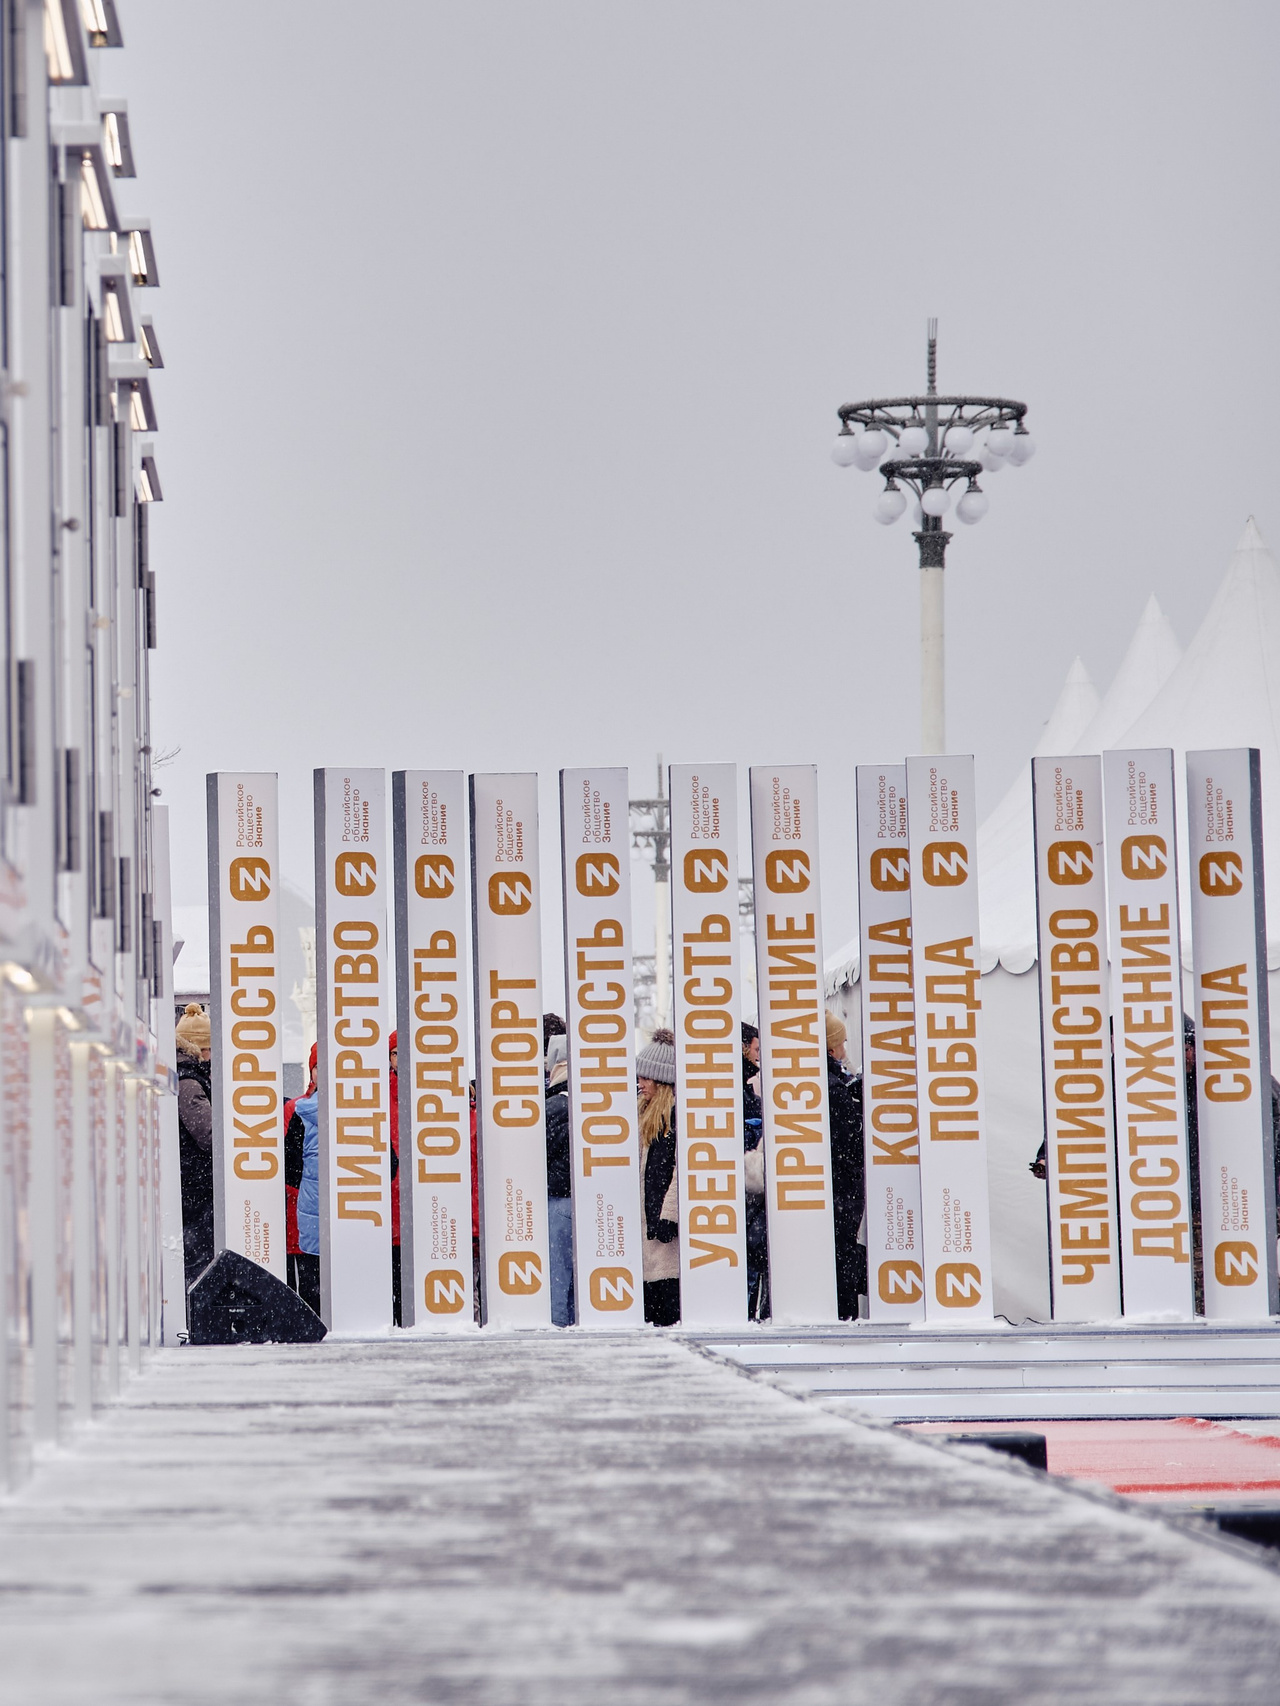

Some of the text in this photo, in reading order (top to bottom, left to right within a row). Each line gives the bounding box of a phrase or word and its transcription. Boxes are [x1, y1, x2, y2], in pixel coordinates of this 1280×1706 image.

[235, 783, 246, 848] Российское
[341, 777, 351, 842] Российское
[350, 788, 362, 843] общество
[420, 780, 430, 845] Российское
[429, 792, 439, 846] общество
[581, 779, 592, 844] Российское
[591, 790, 602, 844] общество
[689, 775, 701, 840] Российское
[700, 786, 711, 840] общество
[710, 797, 720, 840] Знание
[770, 776, 782, 841] Российское
[781, 787, 792, 841] общество
[791, 798, 802, 840] Знание
[876, 774, 887, 839] Российское
[887, 785, 898, 839] общество
[897, 796, 907, 839] Знание
[928, 767, 939, 832] Российское
[939, 778, 950, 833] общество
[949, 789, 960, 832] Знание
[1053, 766, 1064, 832] Российское
[1064, 777, 1075, 832] общество
[1074, 789, 1085, 831] Знание
[1126, 760, 1138, 826] Российское
[1137, 771, 1148, 826] общество
[1147, 782, 1158, 825] Знание
[1204, 777, 1215, 843] Российское
[1214, 788, 1225, 842] общество
[1224, 799, 1235, 842] Знание
[245, 794, 255, 848] общество
[254, 805, 264, 848] Знание
[360, 800, 370, 843] Знание
[438, 803, 448, 846] Знание
[494, 798, 505, 863] Российское
[504, 809, 515, 863] общество
[514, 821, 524, 863] Знание
[601, 801, 612, 844] Знание
[230, 925, 279, 1180] СКОРОСТЬ
[414, 930, 465, 1183] ГОРДОСТЬ
[489, 970, 540, 1127] СПОРТ
[576, 919, 630, 1176] ТОЧНОСТЬ
[868, 918, 919, 1165] КОМАНДА
[924, 937, 981, 1141] ПОБЕДА
[1201, 964, 1252, 1102] СИЛА
[333, 921, 387, 1226] ЛИДЕРСТВО
[767, 913, 825, 1210] ПРИЗНАНИЕ
[1119, 904, 1189, 1262] ДОСТИЖЕНИЕ
[683, 914, 738, 1268] УВЕРЕННОСТЬ
[1048, 909, 1110, 1284] ЧЕМПИОНСТВО
[504, 1178, 515, 1242] Российское
[514, 1188, 525, 1242] общество
[524, 1200, 534, 1242] Знание
[594, 1193, 606, 1258] Российское
[884, 1186, 895, 1251] Российское
[894, 1197, 905, 1251] общество
[941, 1187, 952, 1253] Российское
[952, 1198, 963, 1253] общество
[1219, 1166, 1230, 1232] Российское
[1230, 1177, 1240, 1232] общество
[1239, 1189, 1250, 1231] Знание
[242, 1198, 252, 1258] оссийское
[261, 1222, 270, 1264] Знание
[430, 1195, 440, 1260] Российское
[439, 1206, 449, 1260] общество
[448, 1218, 458, 1260] Знание
[605, 1203, 616, 1258] общество
[615, 1215, 625, 1257] Знание
[904, 1209, 915, 1251] Знание
[962, 1210, 973, 1253] Знание
